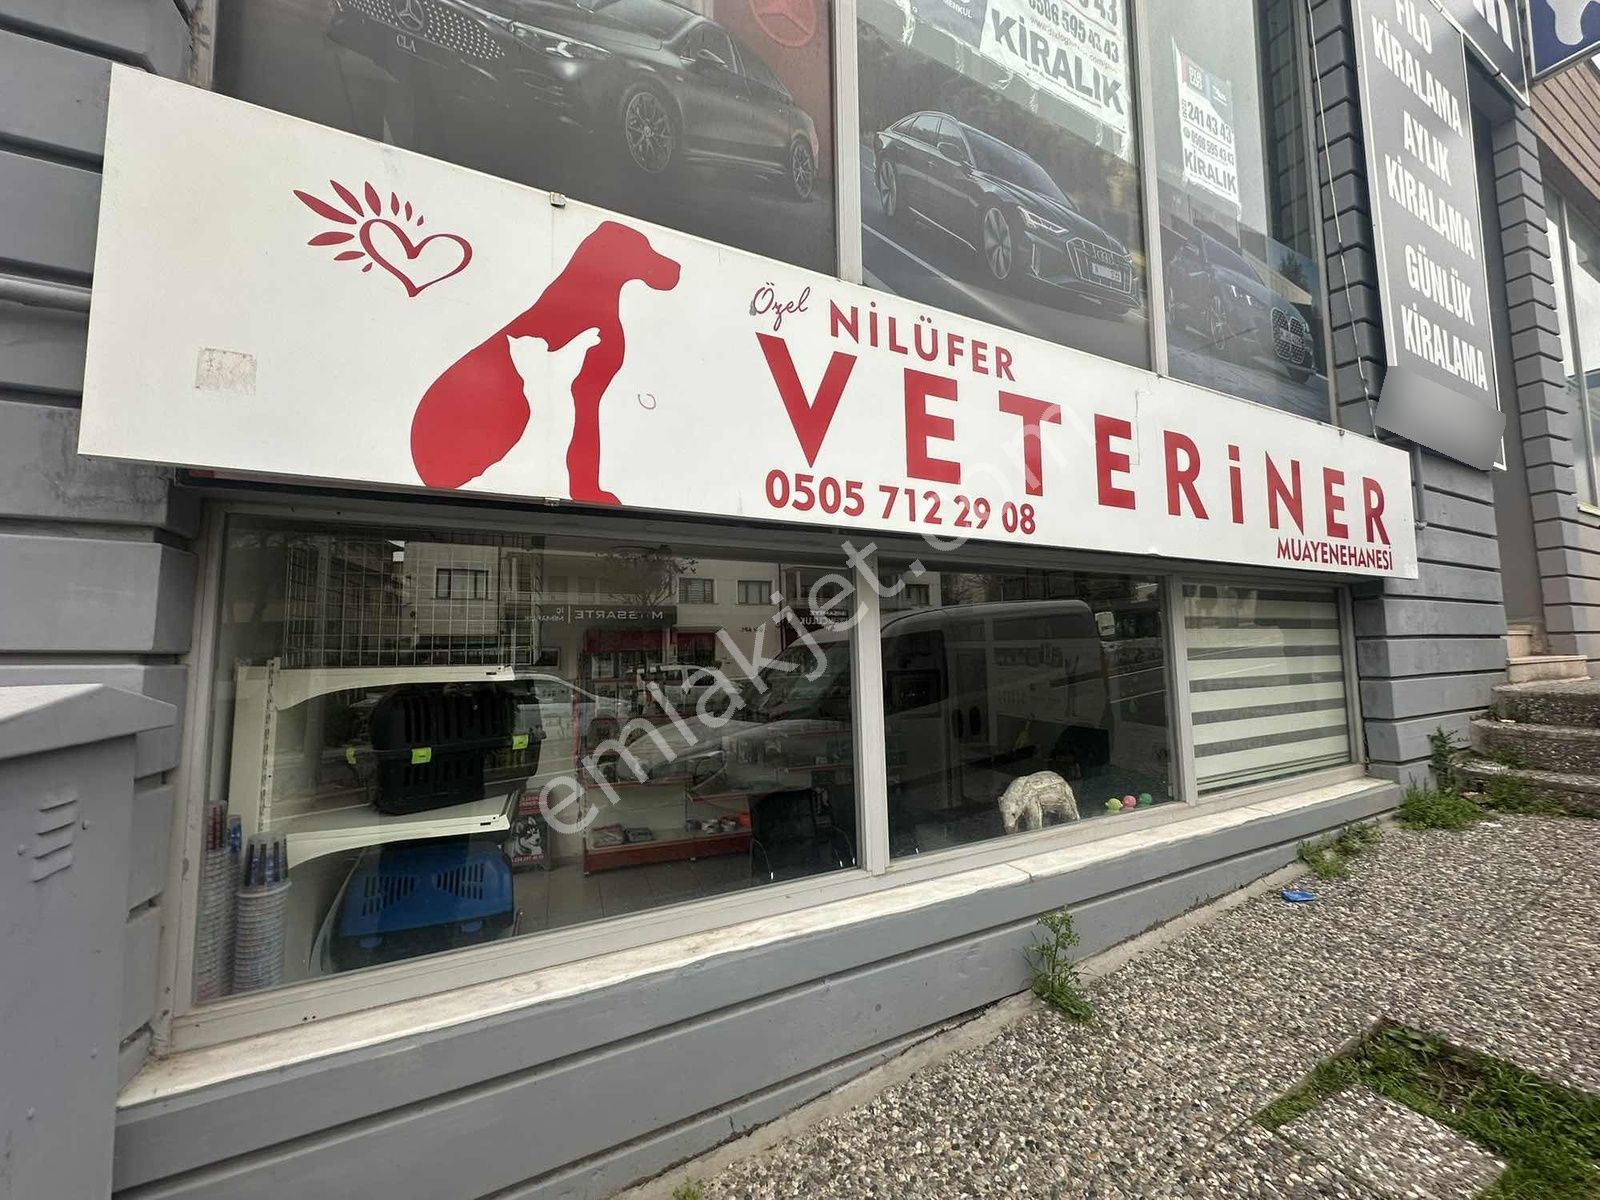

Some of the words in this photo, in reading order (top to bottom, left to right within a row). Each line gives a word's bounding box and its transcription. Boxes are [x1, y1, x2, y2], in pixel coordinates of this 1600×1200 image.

[396, 34, 417, 53] CLA
[991, 8, 1124, 115] KİRALIK
[1061, 10, 1086, 43] 595
[1088, 29, 1103, 53] 43
[1104, 38, 1120, 63] 43
[1371, 13, 1463, 138] KİRALAMA
[1187, 101, 1205, 127] 241
[1206, 113, 1218, 136] 43
[1220, 122, 1232, 144] 43
[1403, 110, 1452, 187] AYLIK
[1184, 148, 1238, 194] KİRALIK
[1385, 153, 1476, 260] KİRALAMA
[1405, 243, 1475, 326] GÜNLÜK
[753, 281, 811, 331] Özel
[829, 298, 1015, 380] NİLÜFER
[1401, 304, 1488, 391] KİRALAMA
[764, 469, 865, 518] 0505
[879, 484, 943, 526] 712
[953, 495, 991, 531] 29
[1001, 502, 1037, 535] 08
[1277, 543, 1393, 571] MUAYENEHANESİ
